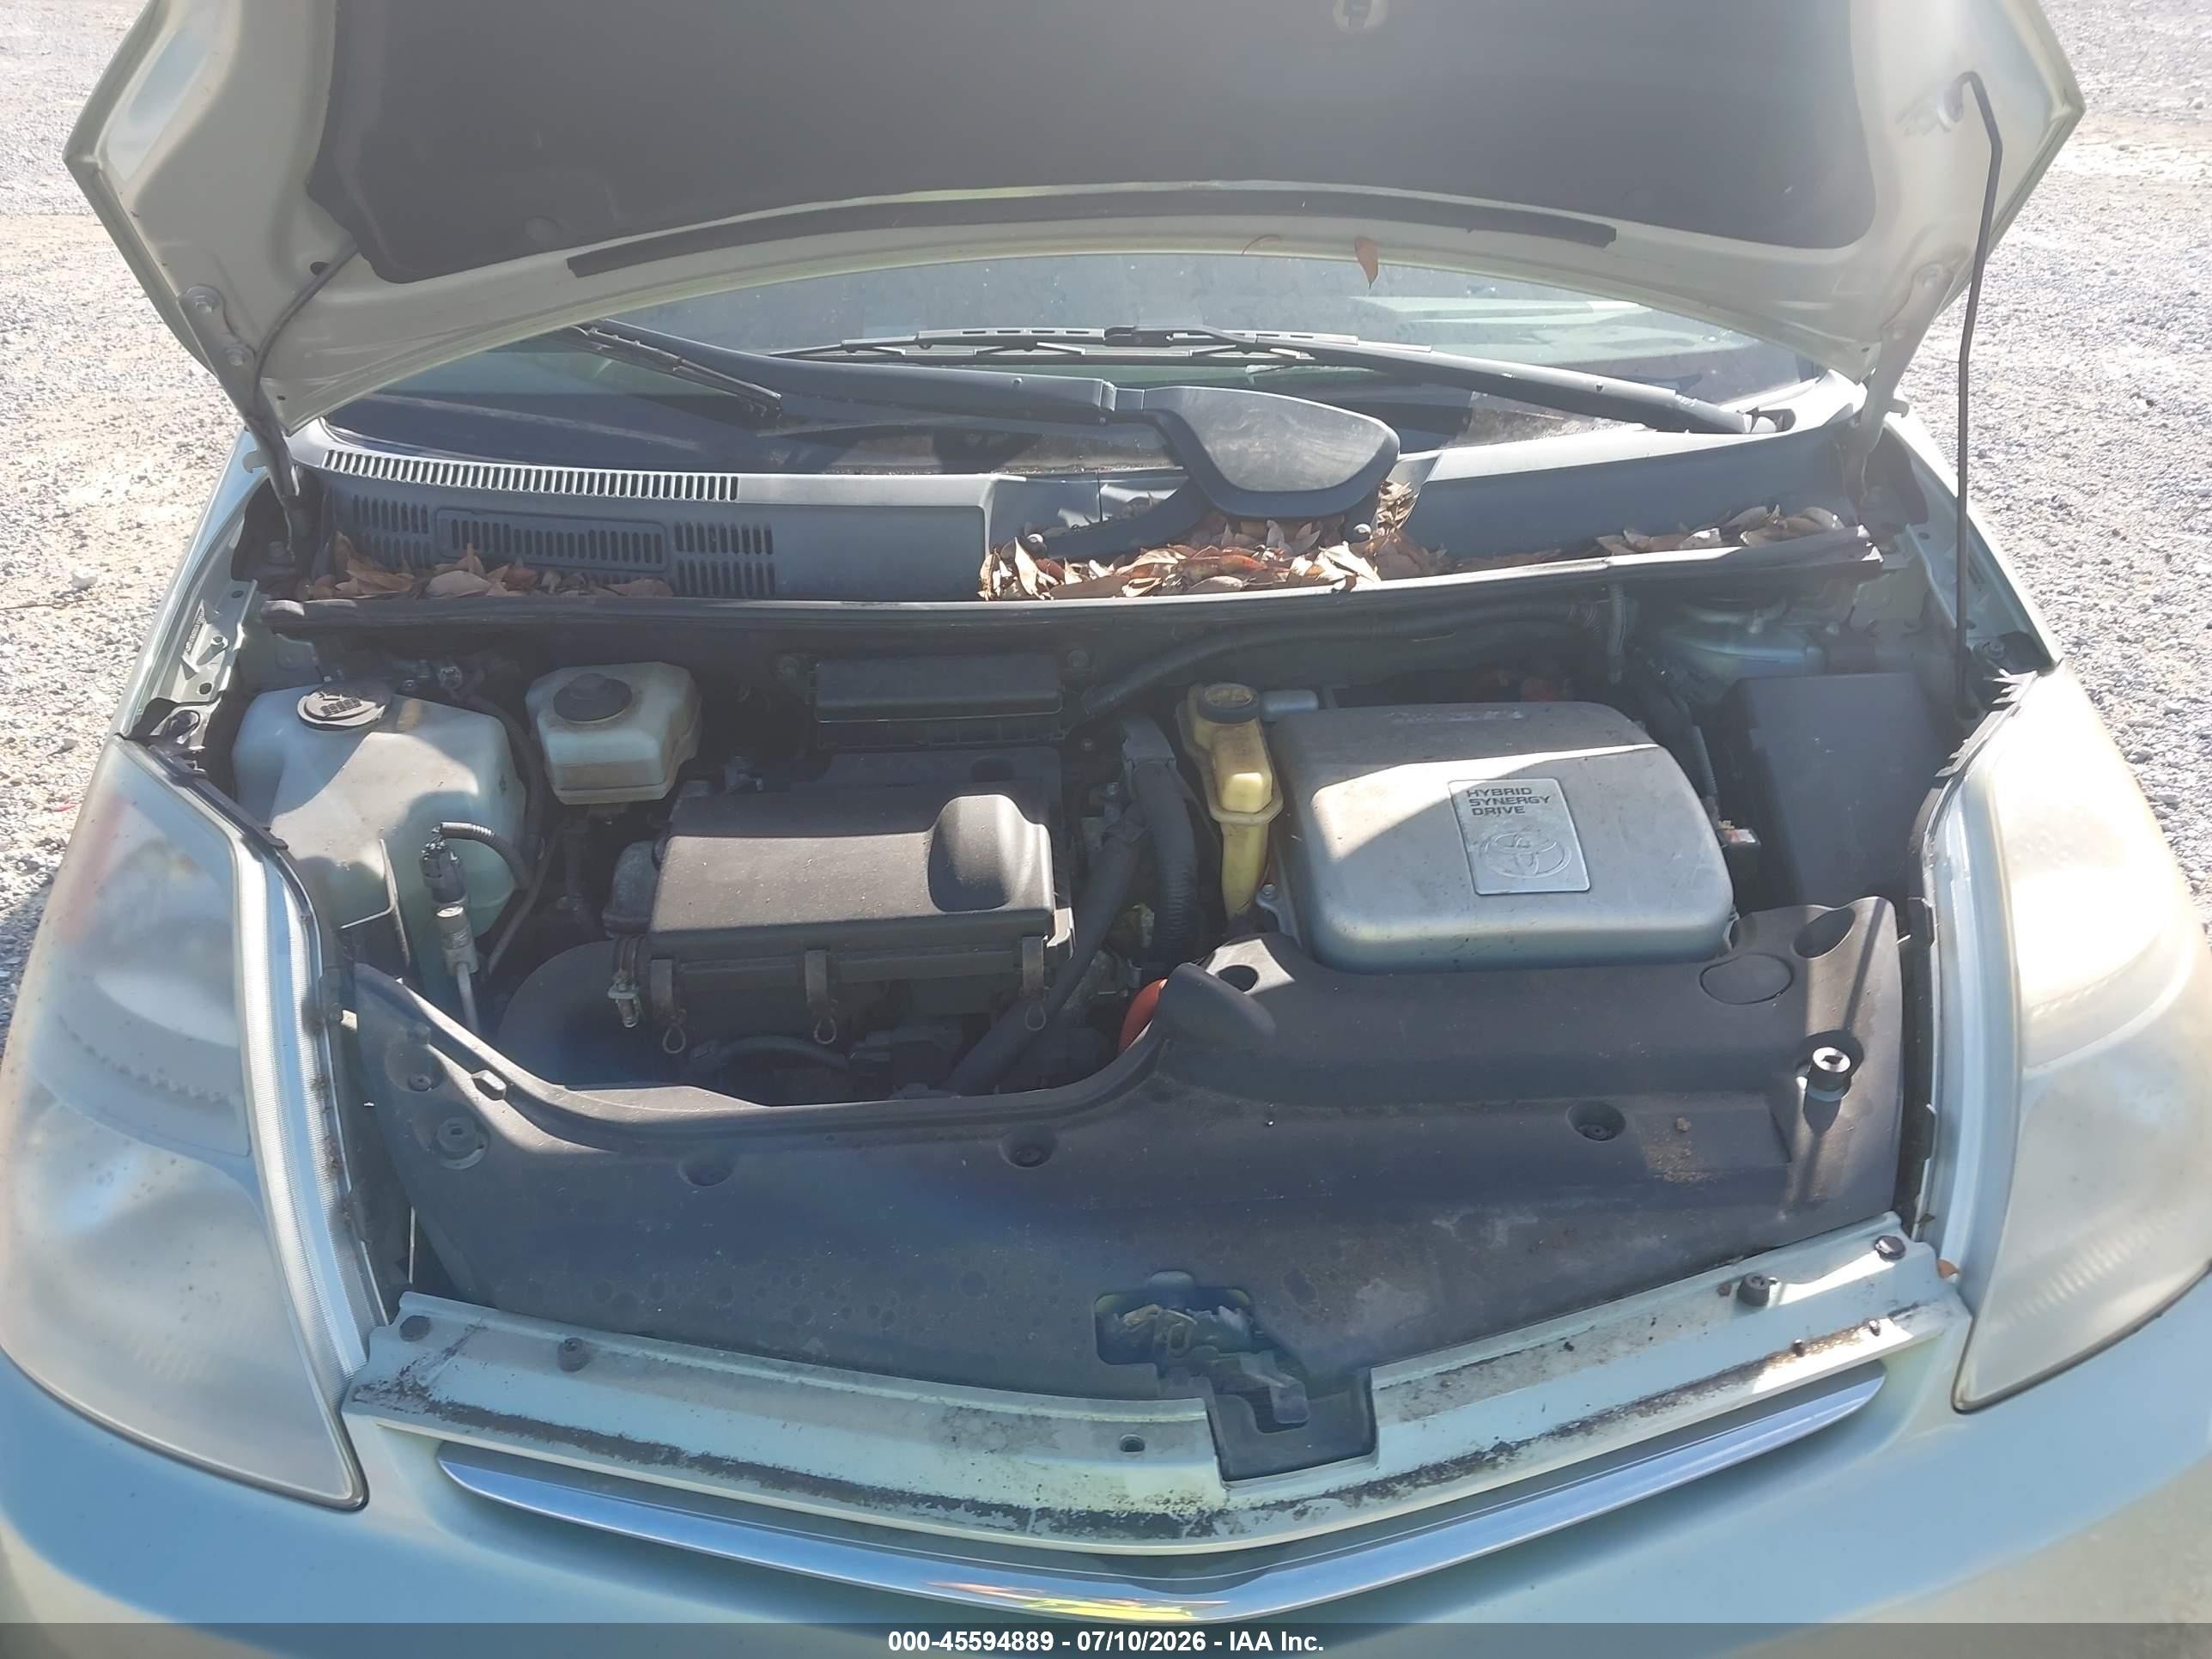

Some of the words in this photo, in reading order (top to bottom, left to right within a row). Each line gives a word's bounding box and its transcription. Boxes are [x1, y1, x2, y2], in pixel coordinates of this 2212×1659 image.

[1467, 787, 1532, 797] HYBRID
[1469, 796, 1550, 806] SYNERGY
[1472, 805, 1525, 816] DRIVE
